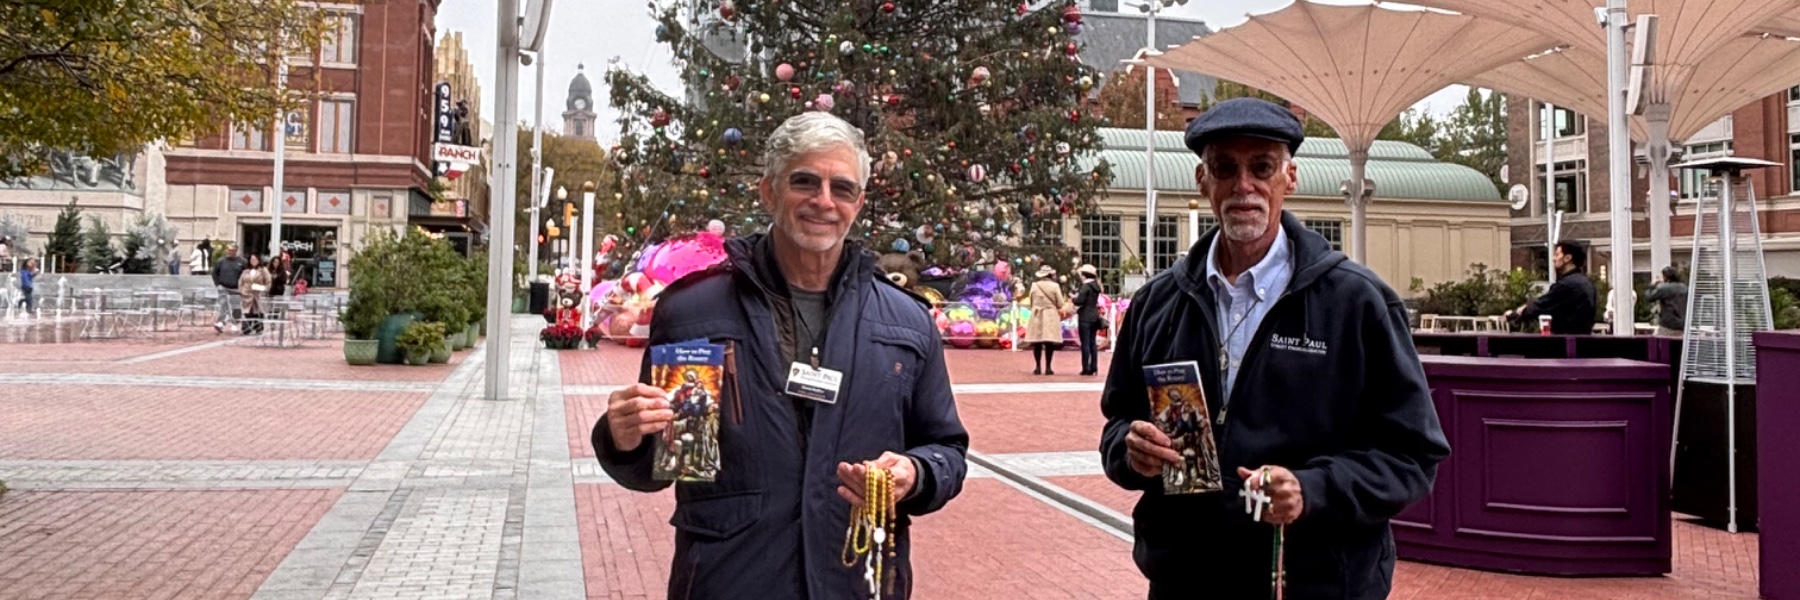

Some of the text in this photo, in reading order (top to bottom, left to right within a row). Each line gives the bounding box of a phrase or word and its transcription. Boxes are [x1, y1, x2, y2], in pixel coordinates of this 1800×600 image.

[438, 147, 476, 160] RANCH
[1271, 333, 1328, 350] SAINT PAUL
